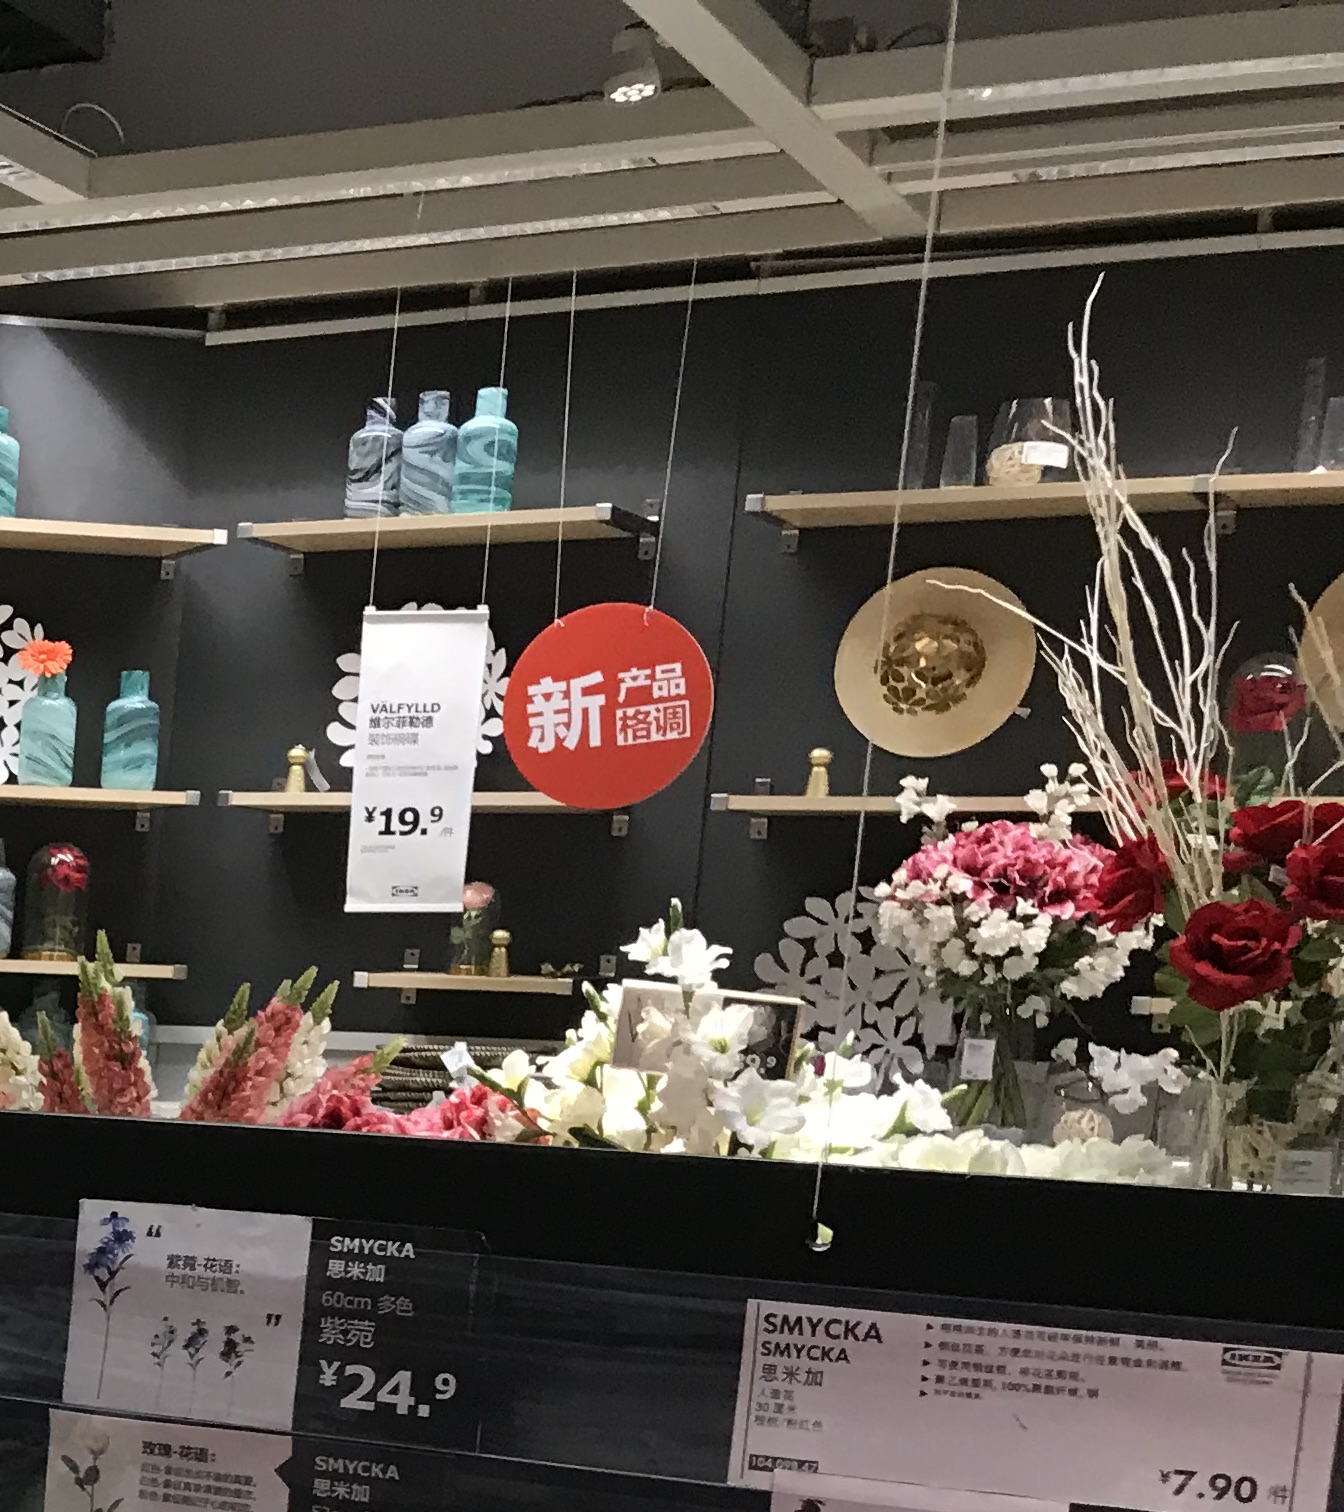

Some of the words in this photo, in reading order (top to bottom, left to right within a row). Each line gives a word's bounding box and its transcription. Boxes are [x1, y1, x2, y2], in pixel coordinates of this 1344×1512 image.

[617, 662, 687, 703] 产品
[370, 701, 441, 714] VÄLFYLLD
[526, 670, 607, 754] 新
[618, 702, 688, 744] 格调
[364, 806, 444, 836] ¥19.9
[329, 1236, 416, 1259] SMYCKA
[326, 1259, 386, 1283] 思米加
[320, 1290, 372, 1311] 60cm
[376, 1295, 414, 1317] 多色
[318, 1316, 376, 1349] 紫菀
[762, 1313, 883, 1344] SMYCKA
[760, 1340, 851, 1364] SMYCKA
[1225, 1350, 1278, 1366] IKEA
[759, 1363, 824, 1387] 思米加
[318, 1359, 458, 1419] ¥24.9
[314, 1455, 400, 1481] SMYCKA
[312, 1478, 372, 1503] 思米加
[1158, 1469, 1257, 1504] ¥7.90
